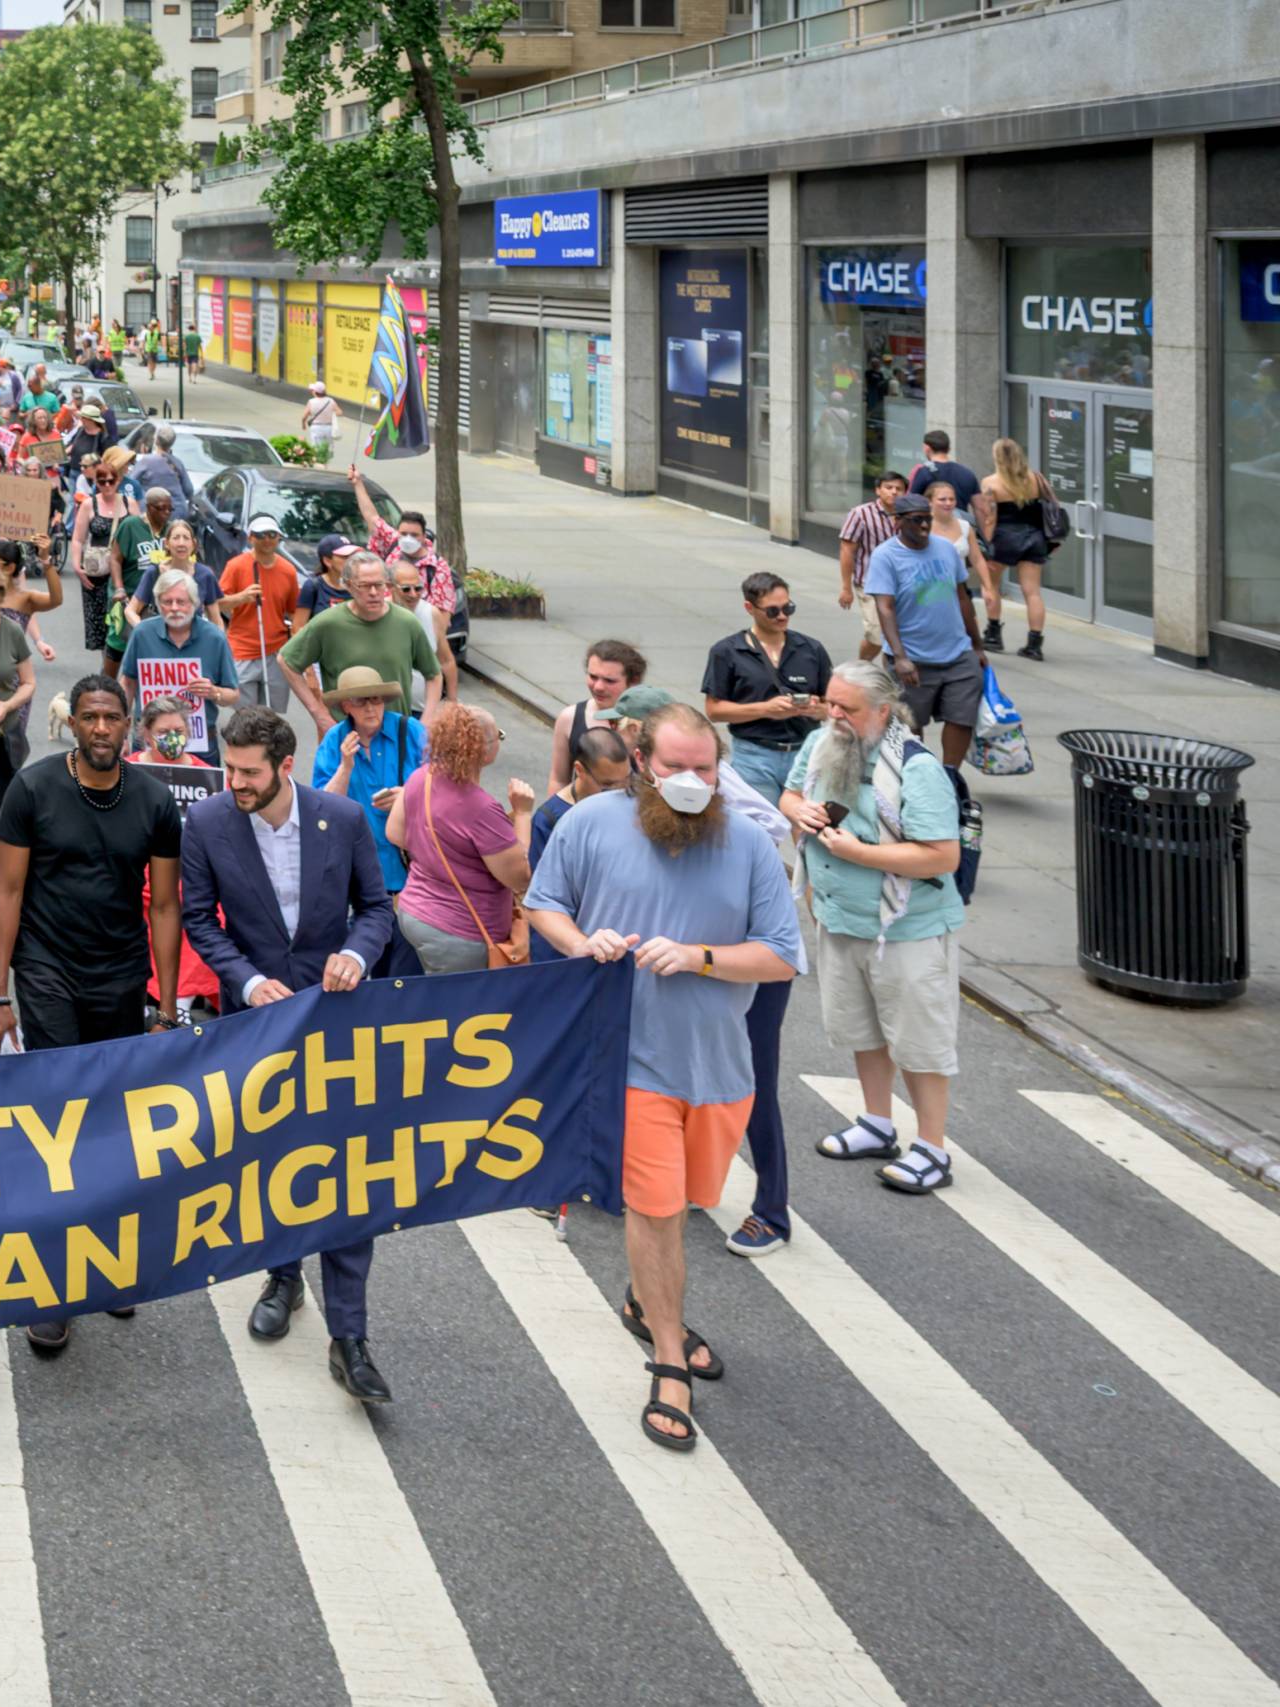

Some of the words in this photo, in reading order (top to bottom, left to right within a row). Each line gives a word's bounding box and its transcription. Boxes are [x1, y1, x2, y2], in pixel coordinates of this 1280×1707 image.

[500, 213, 531, 239] Happy
[542, 210, 590, 232] Cleaners
[828, 262, 911, 294] CHASE
[1022, 295, 1140, 335] CHASE
[140, 662, 199, 686] HANDS
[124, 1013, 513, 1180] RIGHTS
[173, 1098, 544, 1266] RIGHTS
